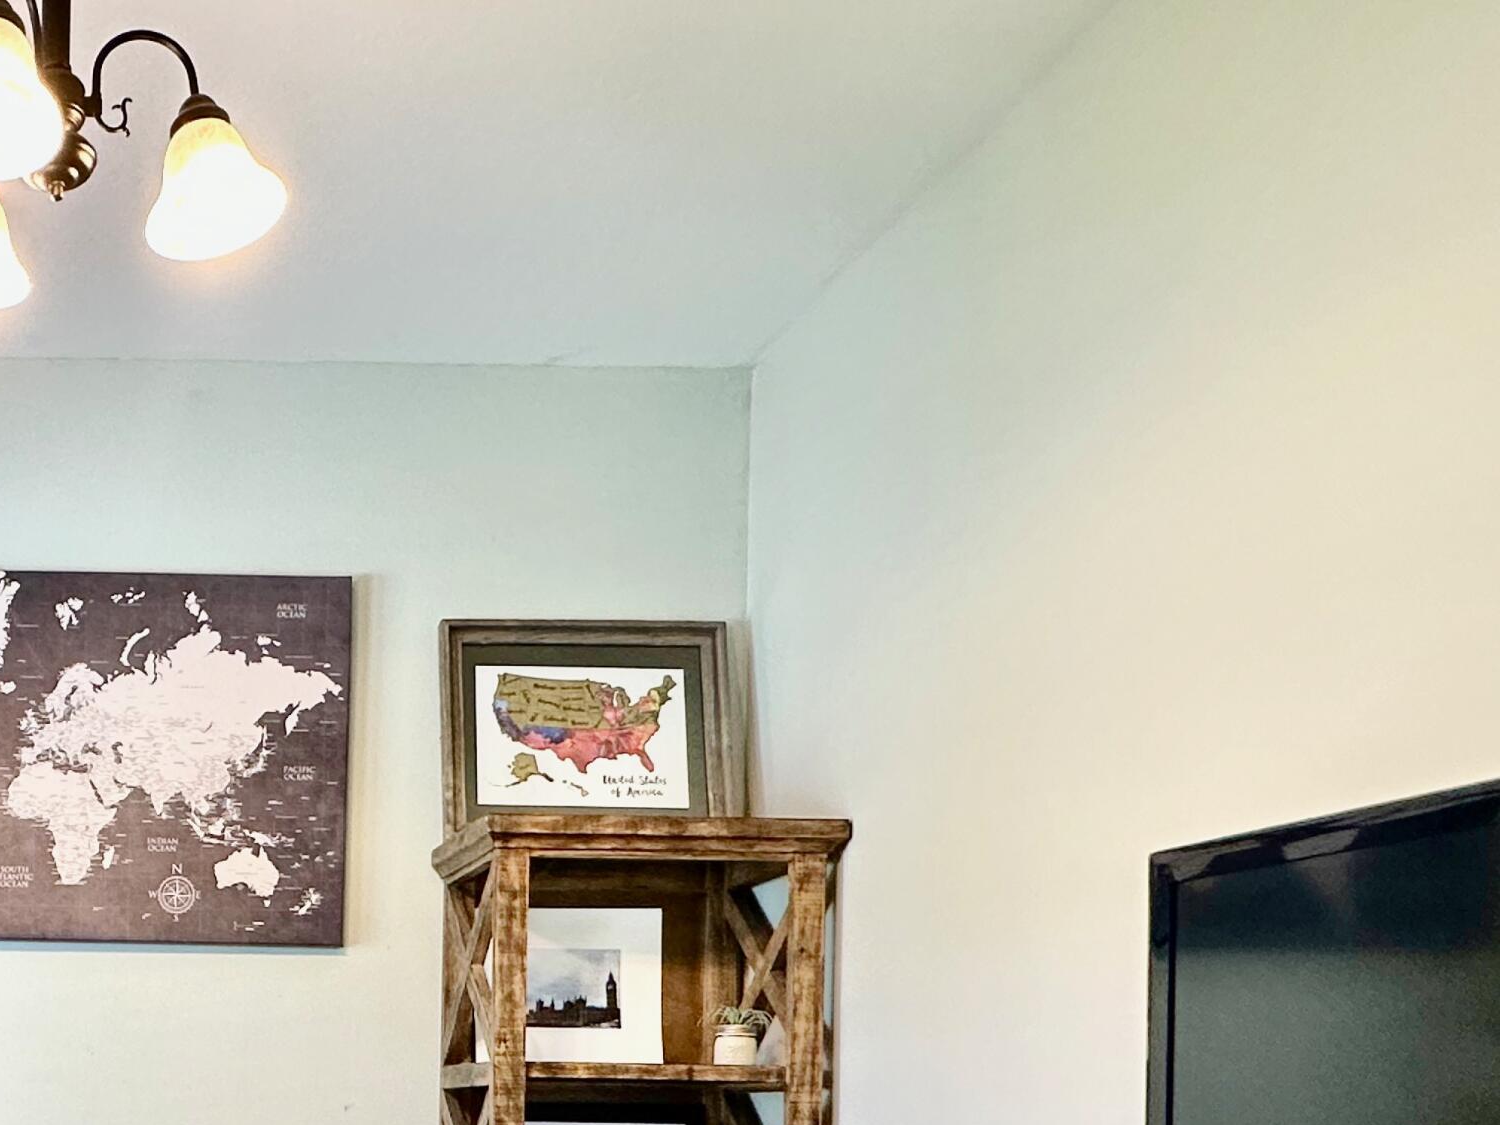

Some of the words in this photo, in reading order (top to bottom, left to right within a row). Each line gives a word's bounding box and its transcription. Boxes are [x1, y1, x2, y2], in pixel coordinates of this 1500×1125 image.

[276, 610, 306, 619] OCEAN
[283, 773, 313, 781] OCEAN
[147, 844, 177, 852] OCEAN
[171, 863, 183, 875] N
[0, 880, 29, 888] OCEAN
